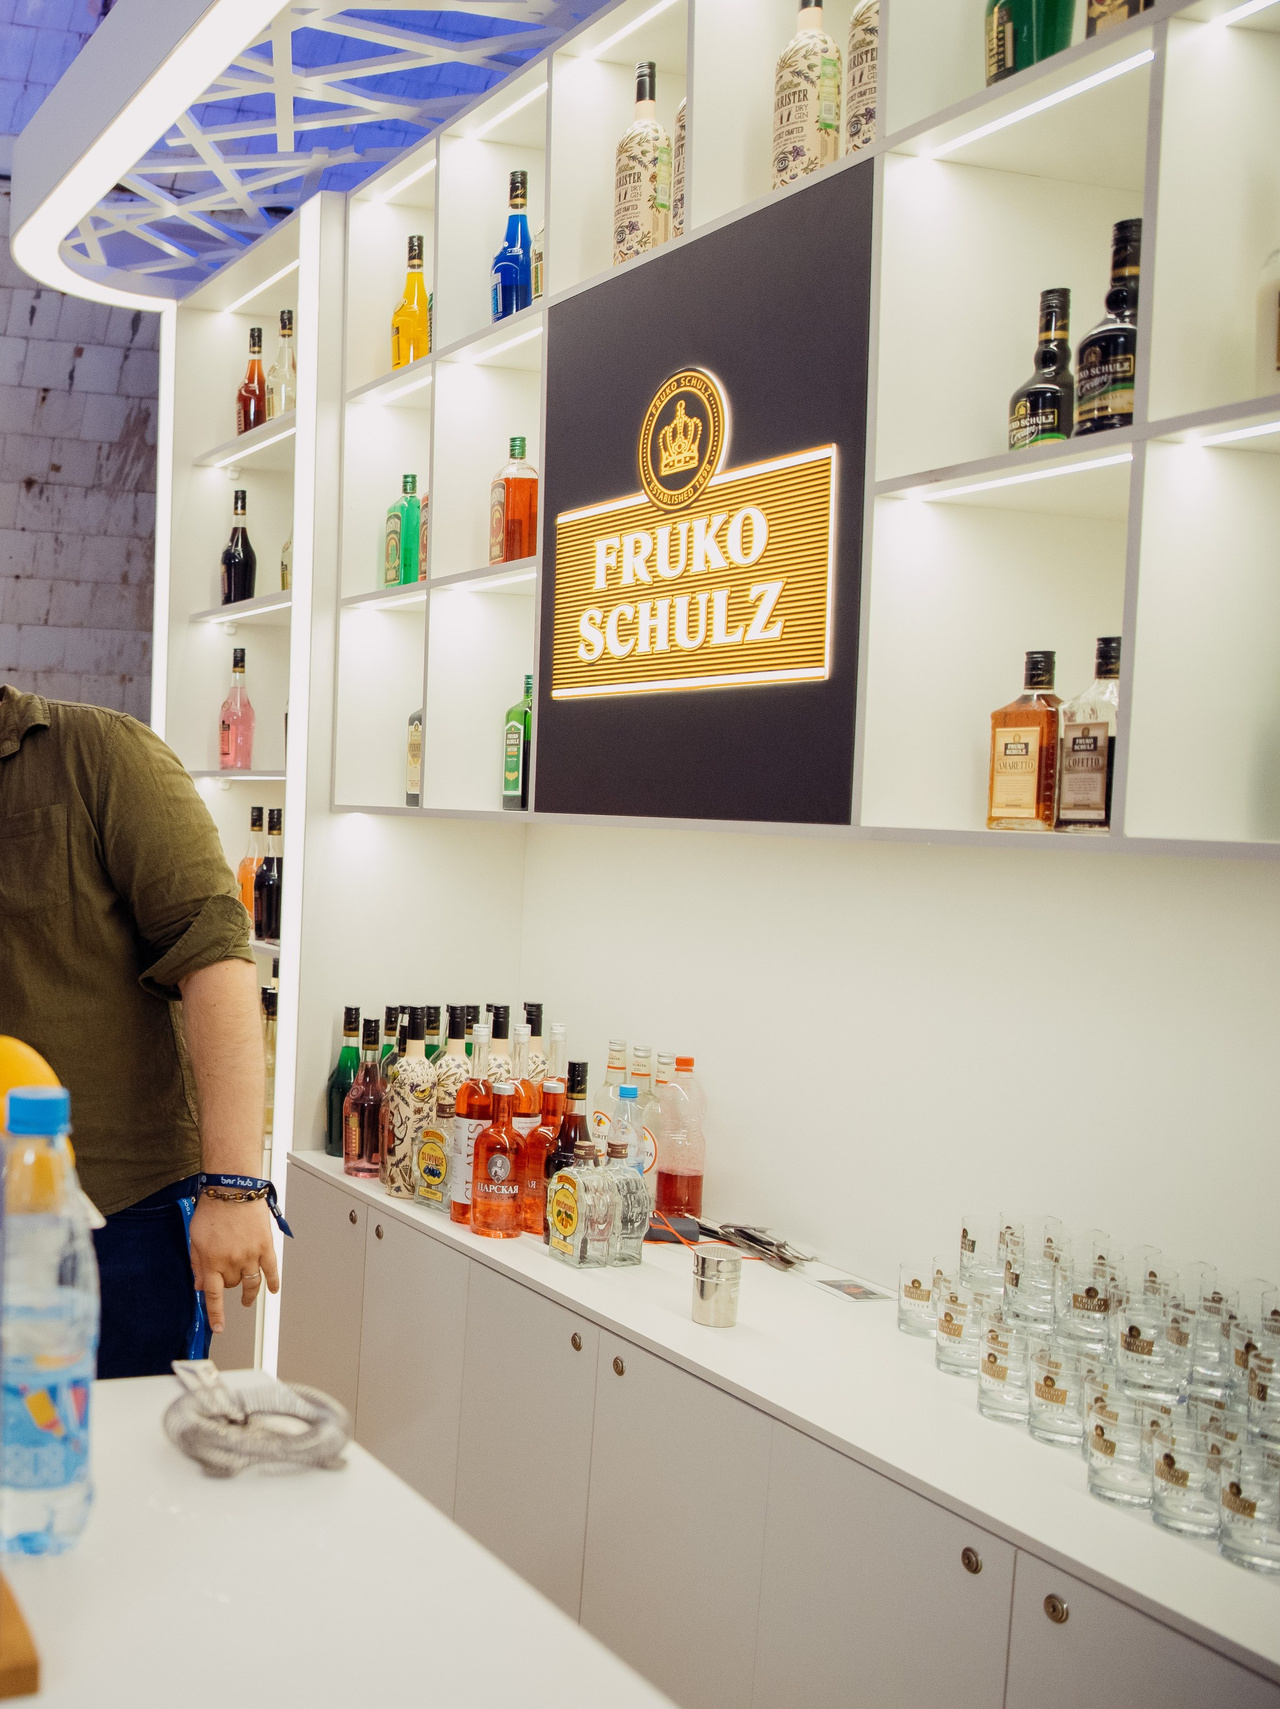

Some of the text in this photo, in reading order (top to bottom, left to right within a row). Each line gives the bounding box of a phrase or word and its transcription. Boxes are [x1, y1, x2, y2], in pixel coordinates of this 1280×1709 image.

[795, 104, 808, 113] DRY
[795, 112, 808, 120] GIN
[1091, 362, 1130, 374] SCHULZ
[651, 376, 713, 415] FRUKO SCHULZ
[1021, 415, 1054, 426] SCHULZ
[649, 463, 712, 504] ESTABLISHED 1898
[593, 506, 769, 592] FRUKO
[577, 578, 787, 664] SCHULZ
[999, 762, 1034, 770] AMARETTO
[237, 1177, 253, 1187] hub
[477, 1182, 519, 1194] ЦАРСКАЯ
